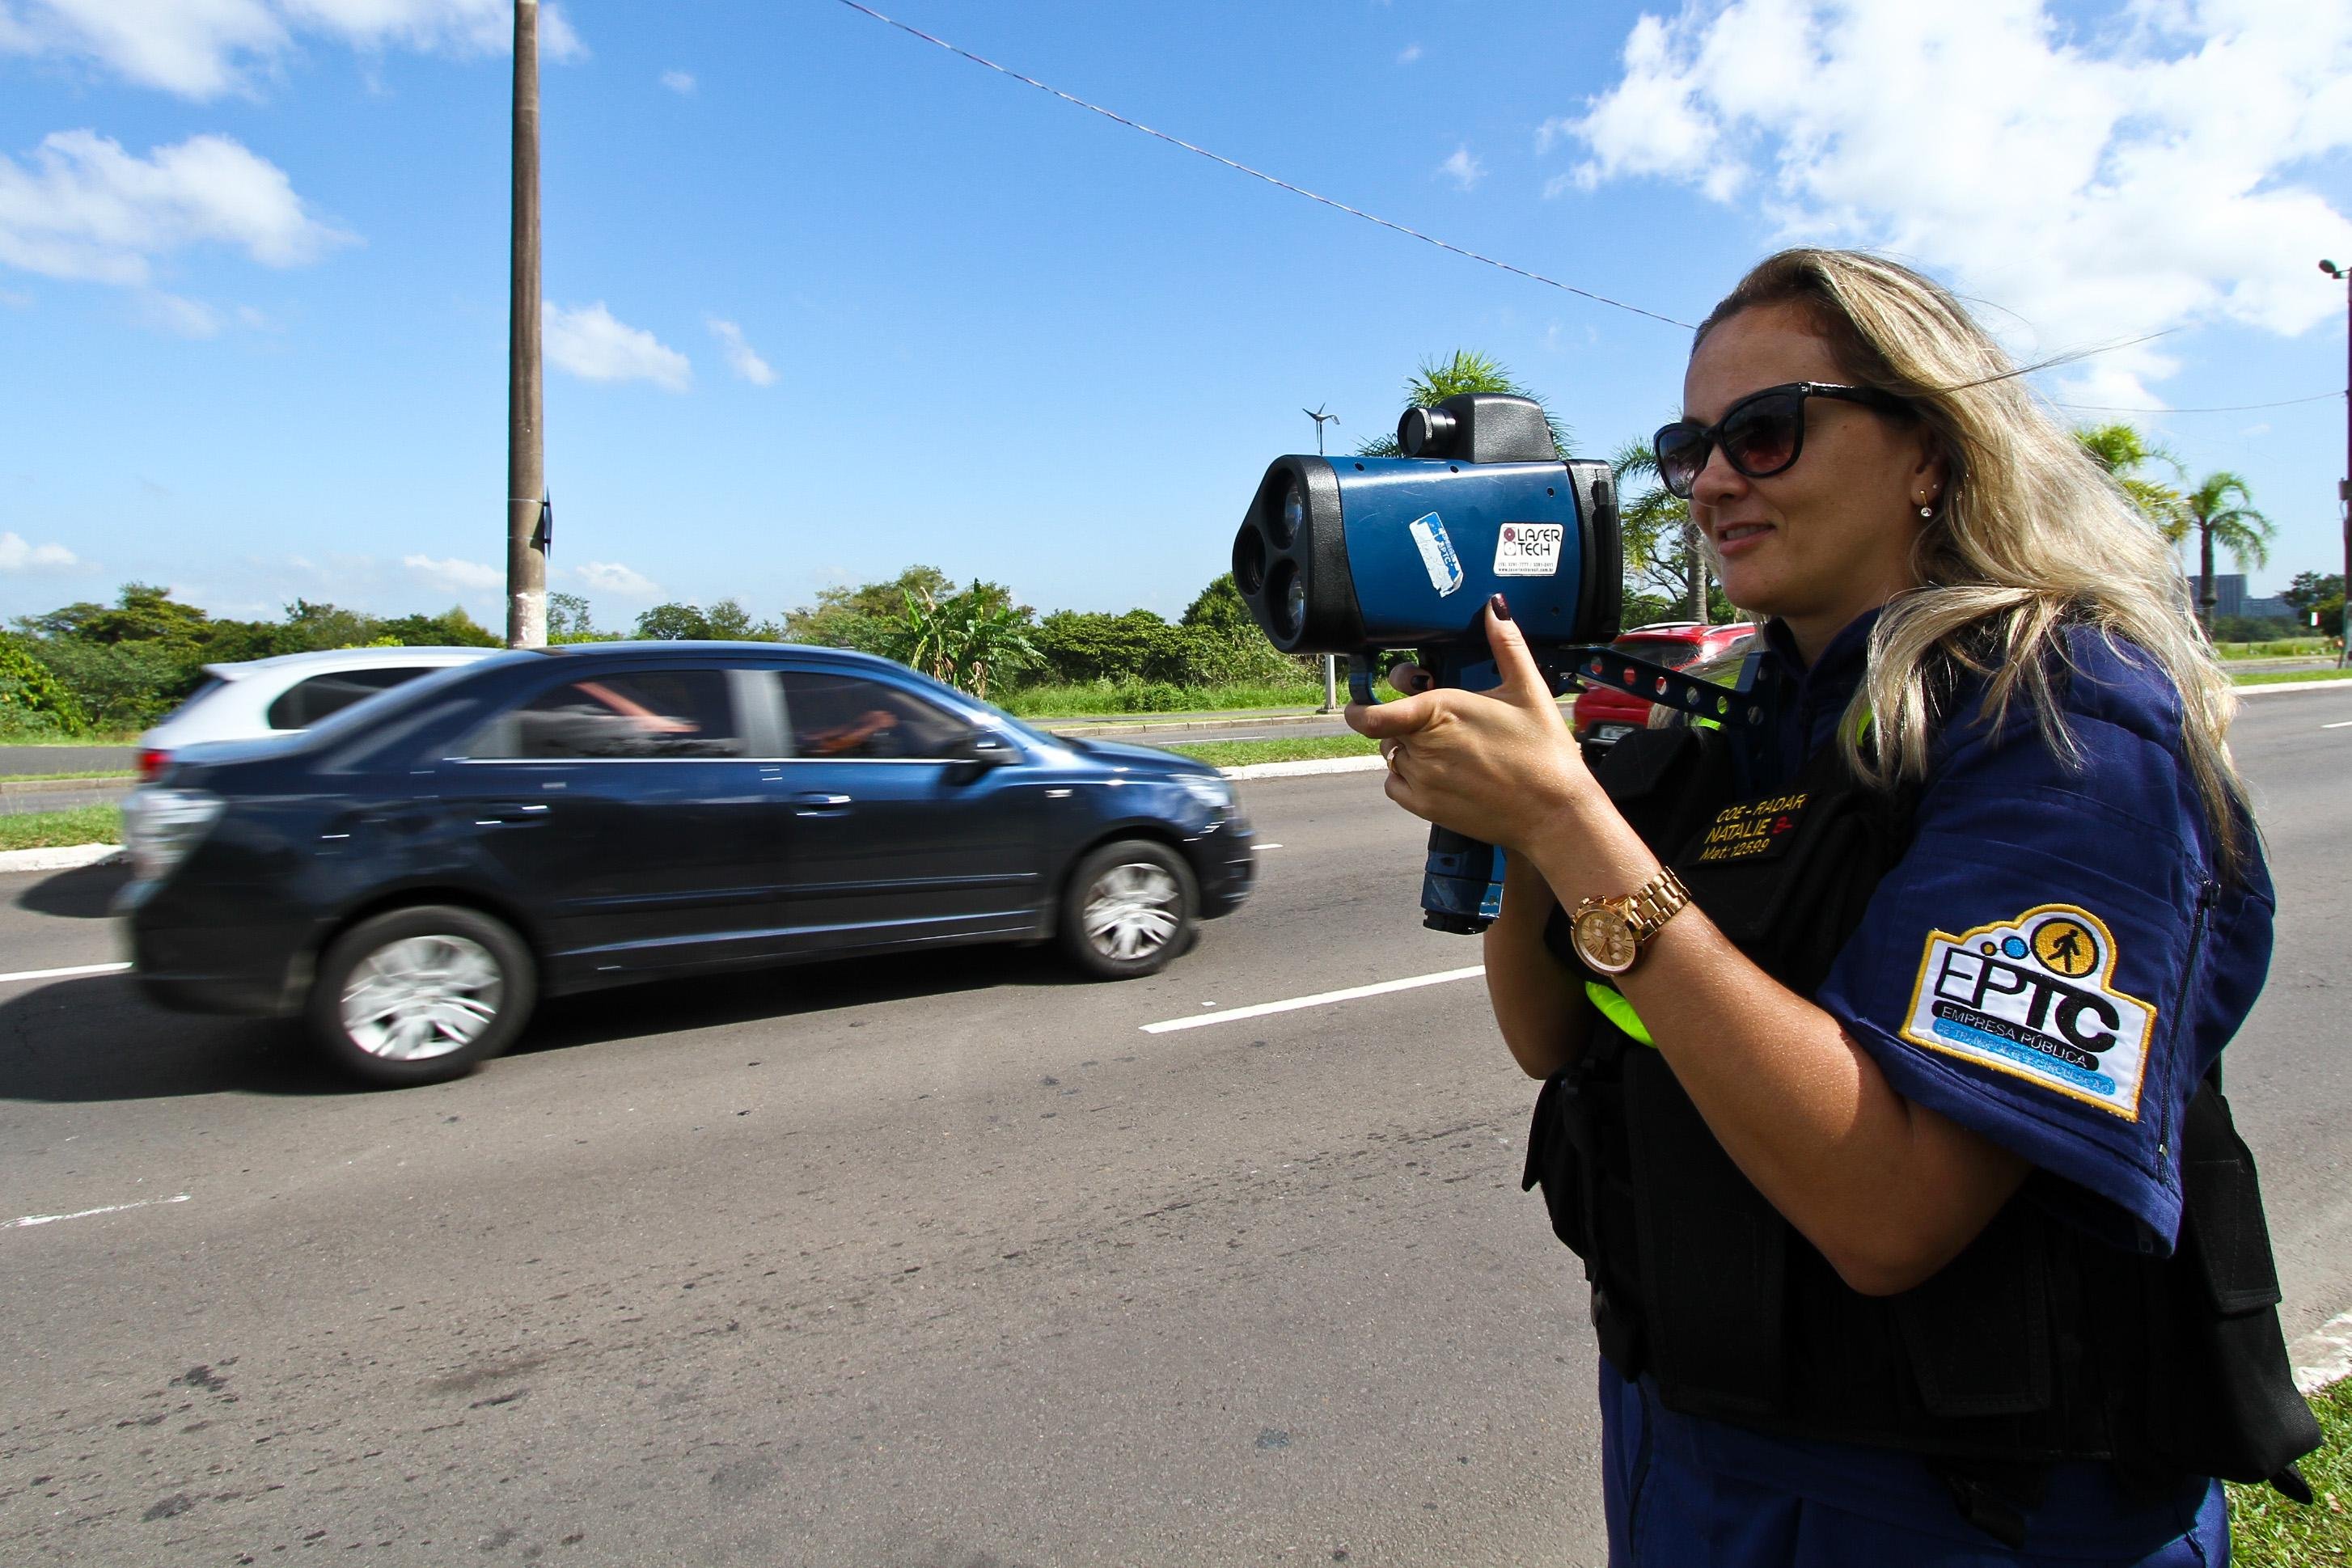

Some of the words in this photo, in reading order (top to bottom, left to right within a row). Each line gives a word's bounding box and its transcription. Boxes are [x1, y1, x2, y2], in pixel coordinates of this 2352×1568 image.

[1517, 528, 1561, 542] LASER
[1517, 543, 1550, 556] TECH
[1716, 805, 1747, 823] COE
[1753, 793, 1808, 816] RADAR
[1704, 818, 1773, 844] NATALIE
[1730, 838, 1770, 857] 12599
[1934, 947, 2120, 1053] EPTC
[1941, 1006, 2016, 1040] EMPRESA
[2021, 1029, 2088, 1068] PÚBLICA
